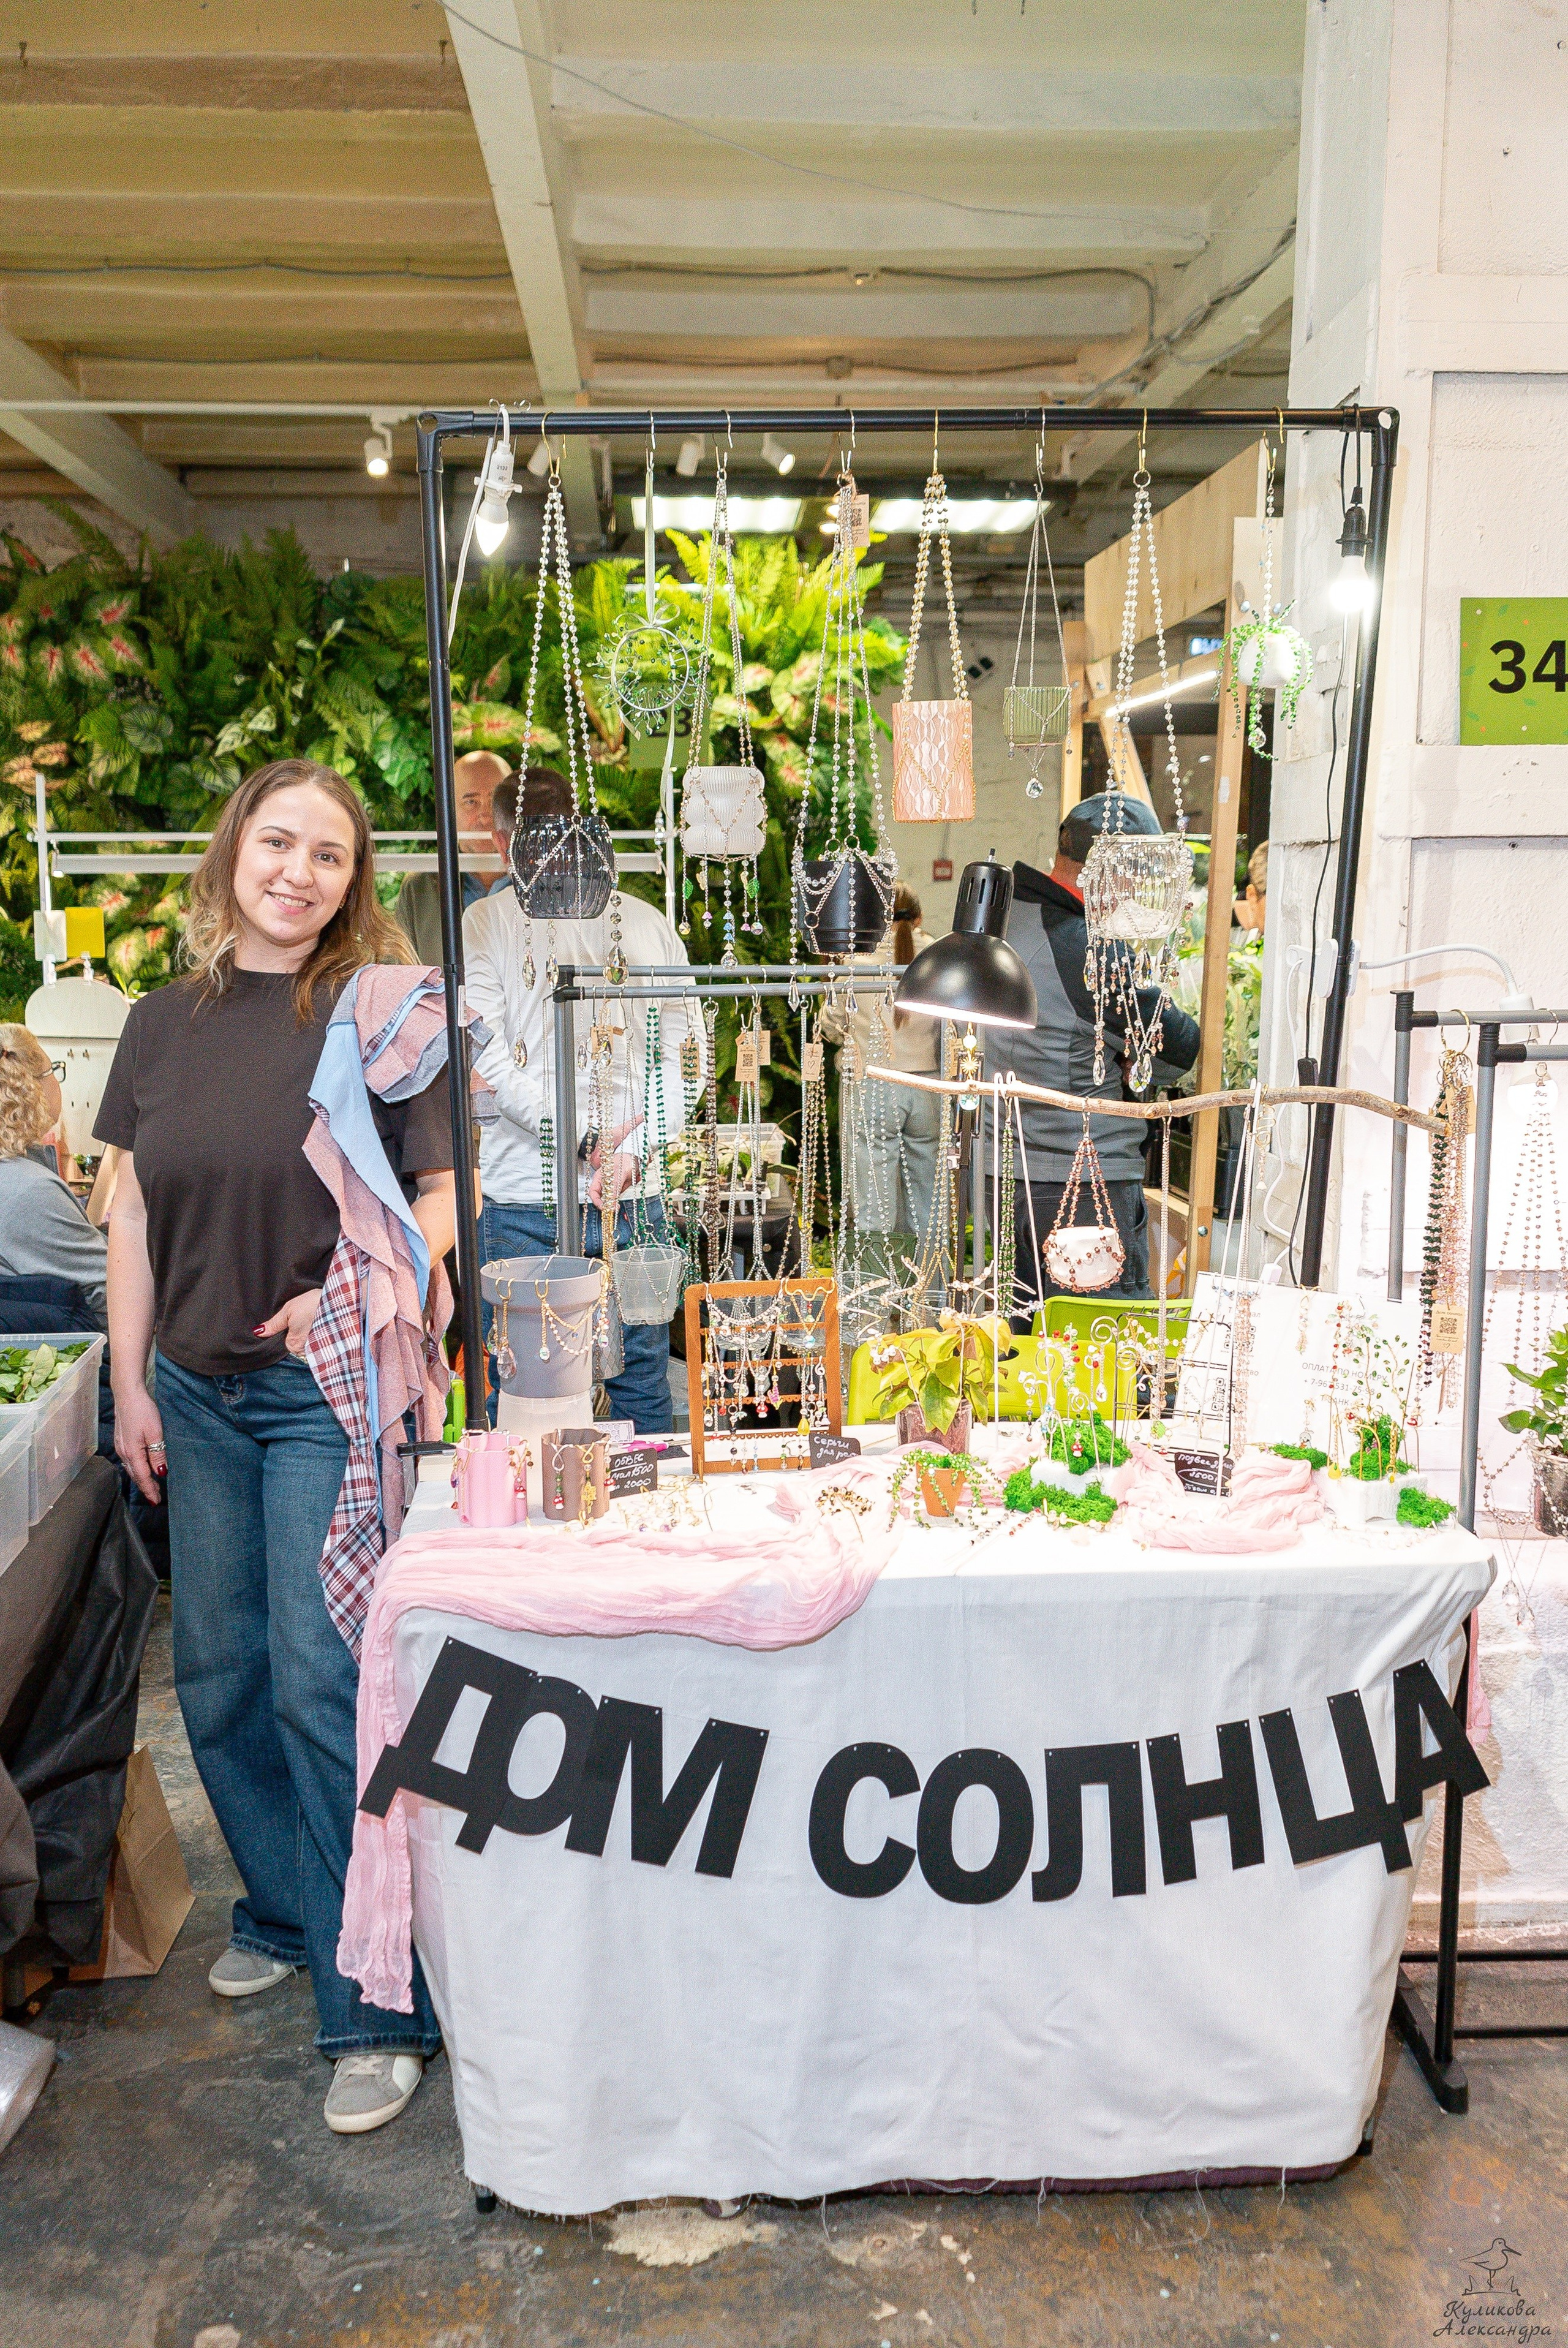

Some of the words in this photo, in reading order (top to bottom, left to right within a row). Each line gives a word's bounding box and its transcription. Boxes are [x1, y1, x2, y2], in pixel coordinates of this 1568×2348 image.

[1488, 640, 1568, 693] 34
[614, 1453, 644, 1468] ОБВЕС
[816, 1448, 834, 1459] для
[631, 1463, 654, 1477] 1500
[624, 1478, 651, 1489] 2000
[358, 1636, 770, 1879] ДОМ
[808, 1658, 1490, 1904] СОЛНЦА
